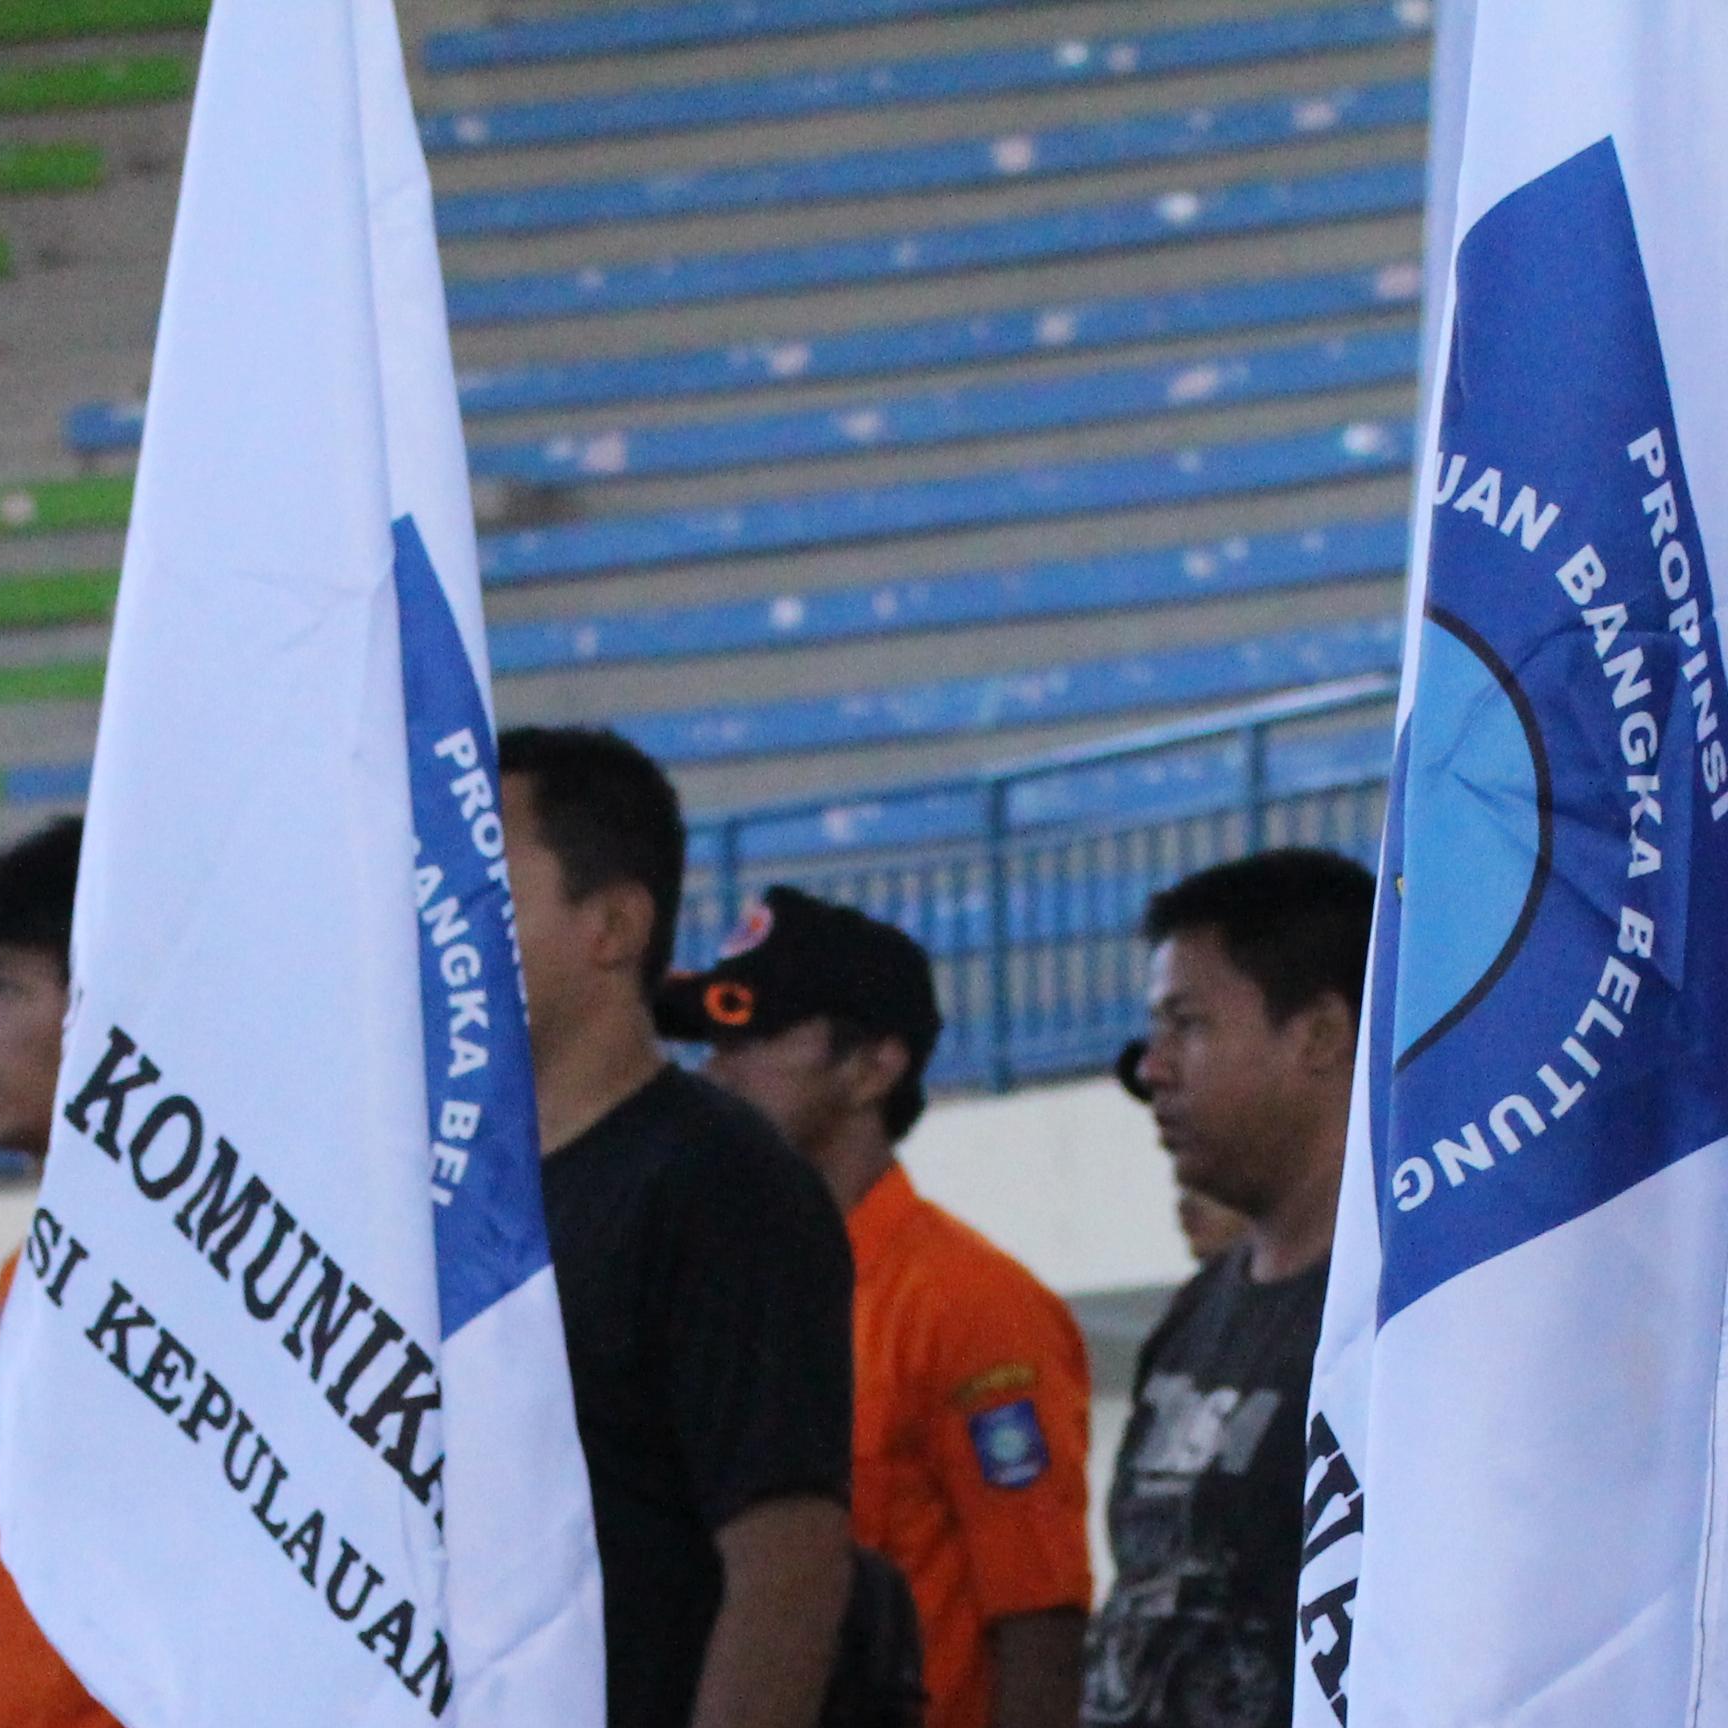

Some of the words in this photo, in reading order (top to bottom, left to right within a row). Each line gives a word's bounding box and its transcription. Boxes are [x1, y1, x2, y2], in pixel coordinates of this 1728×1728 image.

[1556, 544, 1664, 880] BANGKA
[412, 836, 490, 1079] ANGKA
[1393, 905, 1656, 1213] BELITUNG
[83, 1279, 456, 1720] KEPULAUAN
